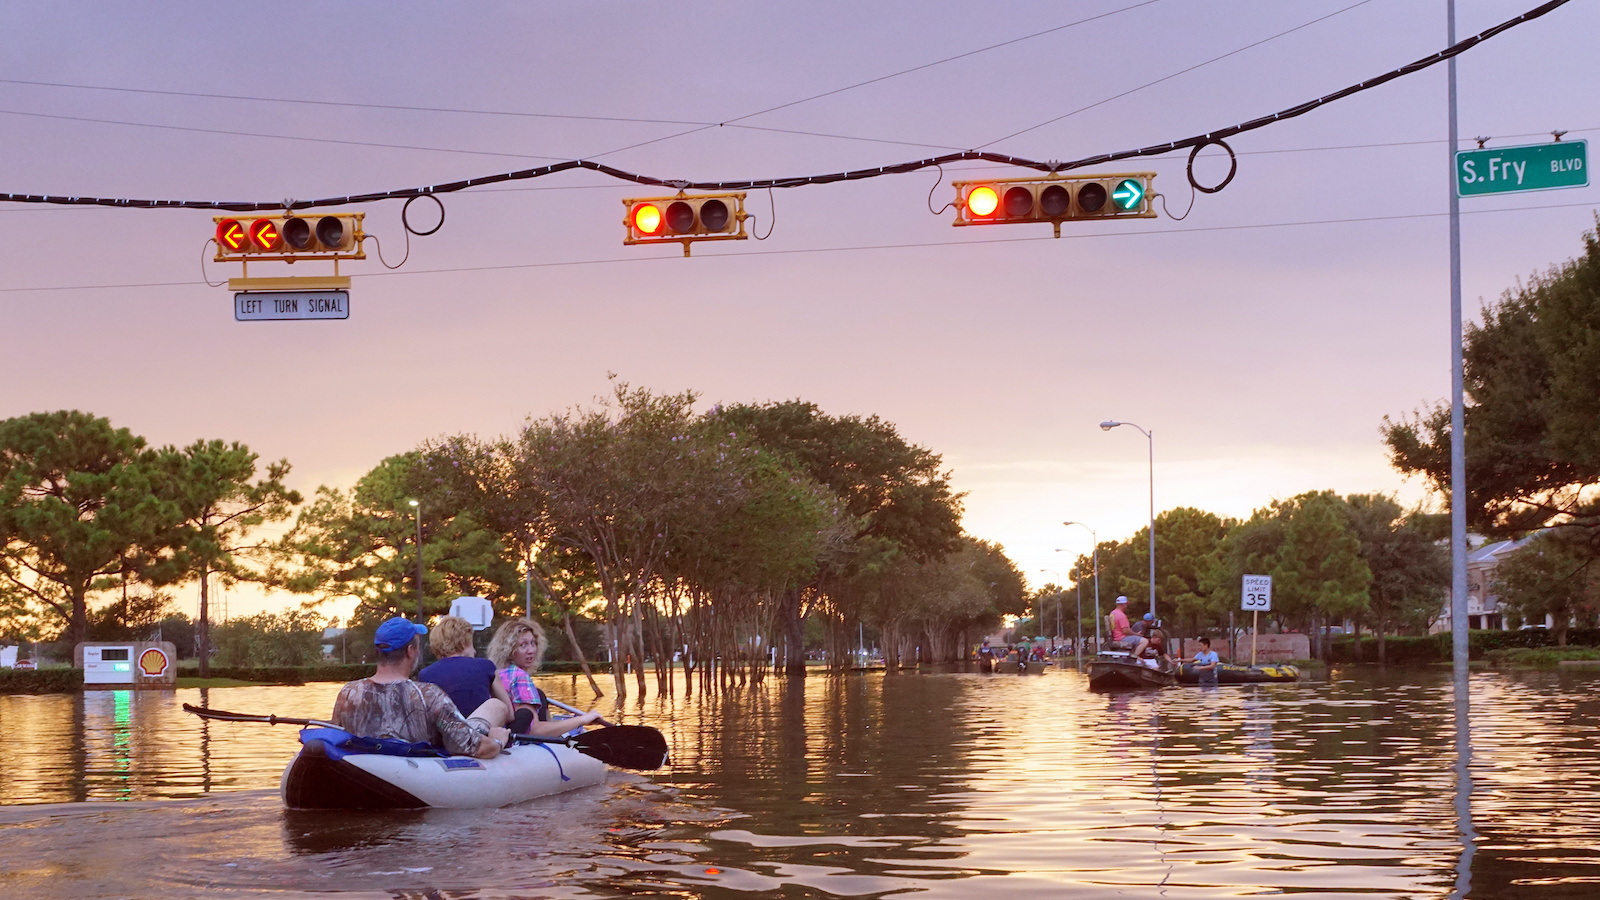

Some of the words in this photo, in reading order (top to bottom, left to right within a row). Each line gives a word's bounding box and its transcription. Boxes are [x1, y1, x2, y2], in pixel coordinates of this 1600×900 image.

[1550, 157, 1583, 173] BLVD
[241, 300, 262, 314] LEFT
[273, 299, 298, 313] TURN
[308, 298, 343, 313] SIGNAL
[1245, 578, 1269, 586] SPEED
[1246, 593, 1267, 606] 35
